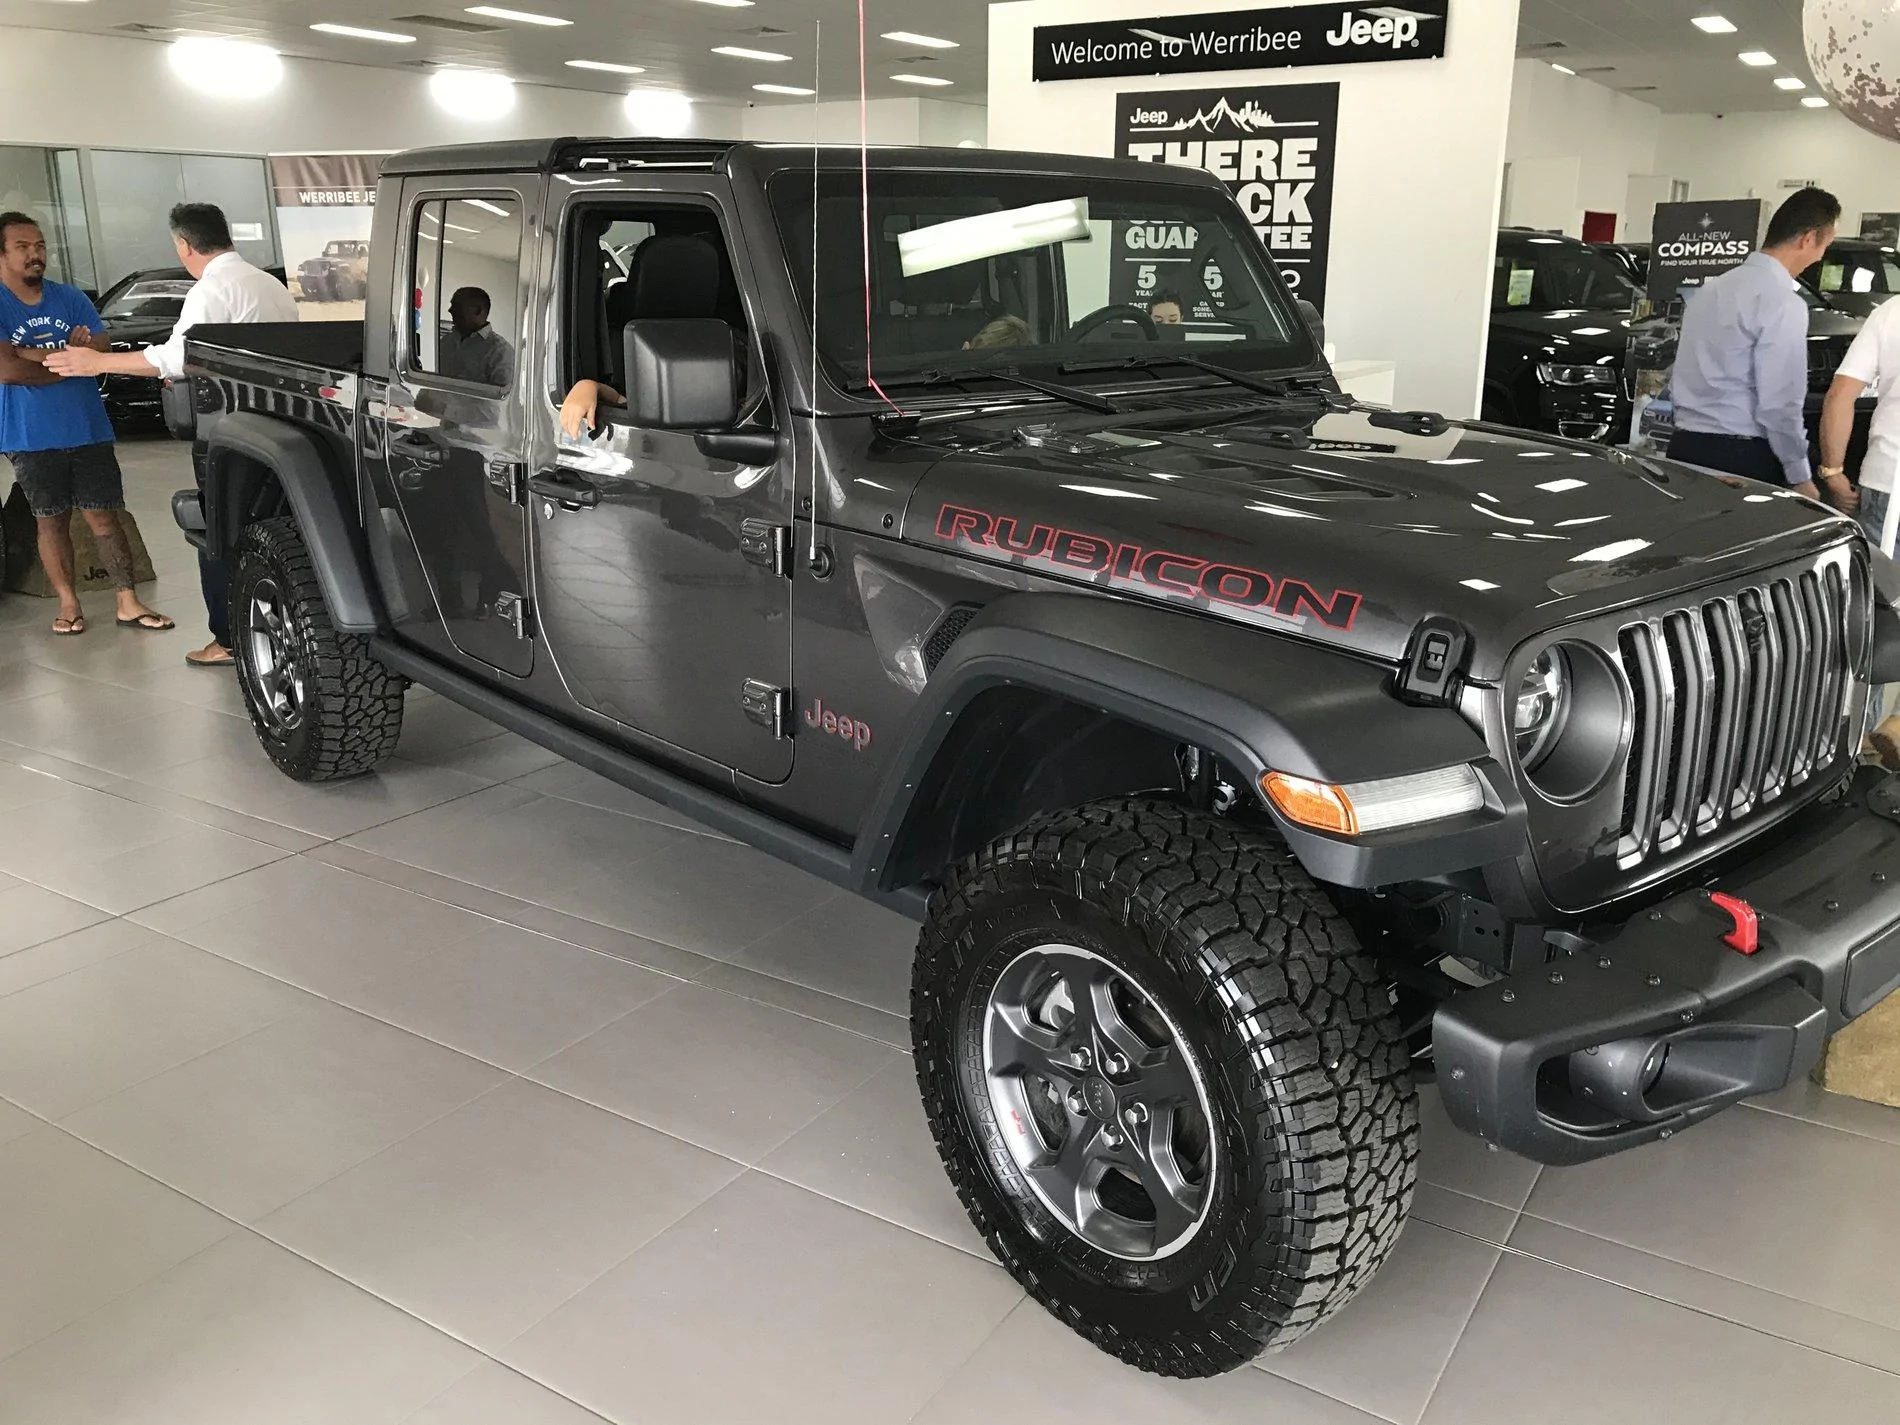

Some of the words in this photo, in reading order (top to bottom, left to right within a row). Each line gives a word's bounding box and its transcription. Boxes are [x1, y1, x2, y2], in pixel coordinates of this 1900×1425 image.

[1051, 37, 1152, 65] Welcome
[1159, 37, 1183, 58] to
[1189, 26, 1302, 56] Werribee
[1130, 108, 1168, 124] Jeep
[299, 191, 360, 203] WERRIBEE
[363, 191, 376, 203] JE
[1678, 231, 1731, 241] ALL-NEW
[1658, 240, 1749, 257] COMPASS
[1137, 265, 1157, 289] 5
[1203, 265, 1223, 290] 5
[11, 326, 27, 347] NEW
[26, 316, 52, 328] YORK
[54, 318, 71, 333] CIT
[934, 504, 1363, 632] RUBICON
[804, 697, 872, 752] Jeep
